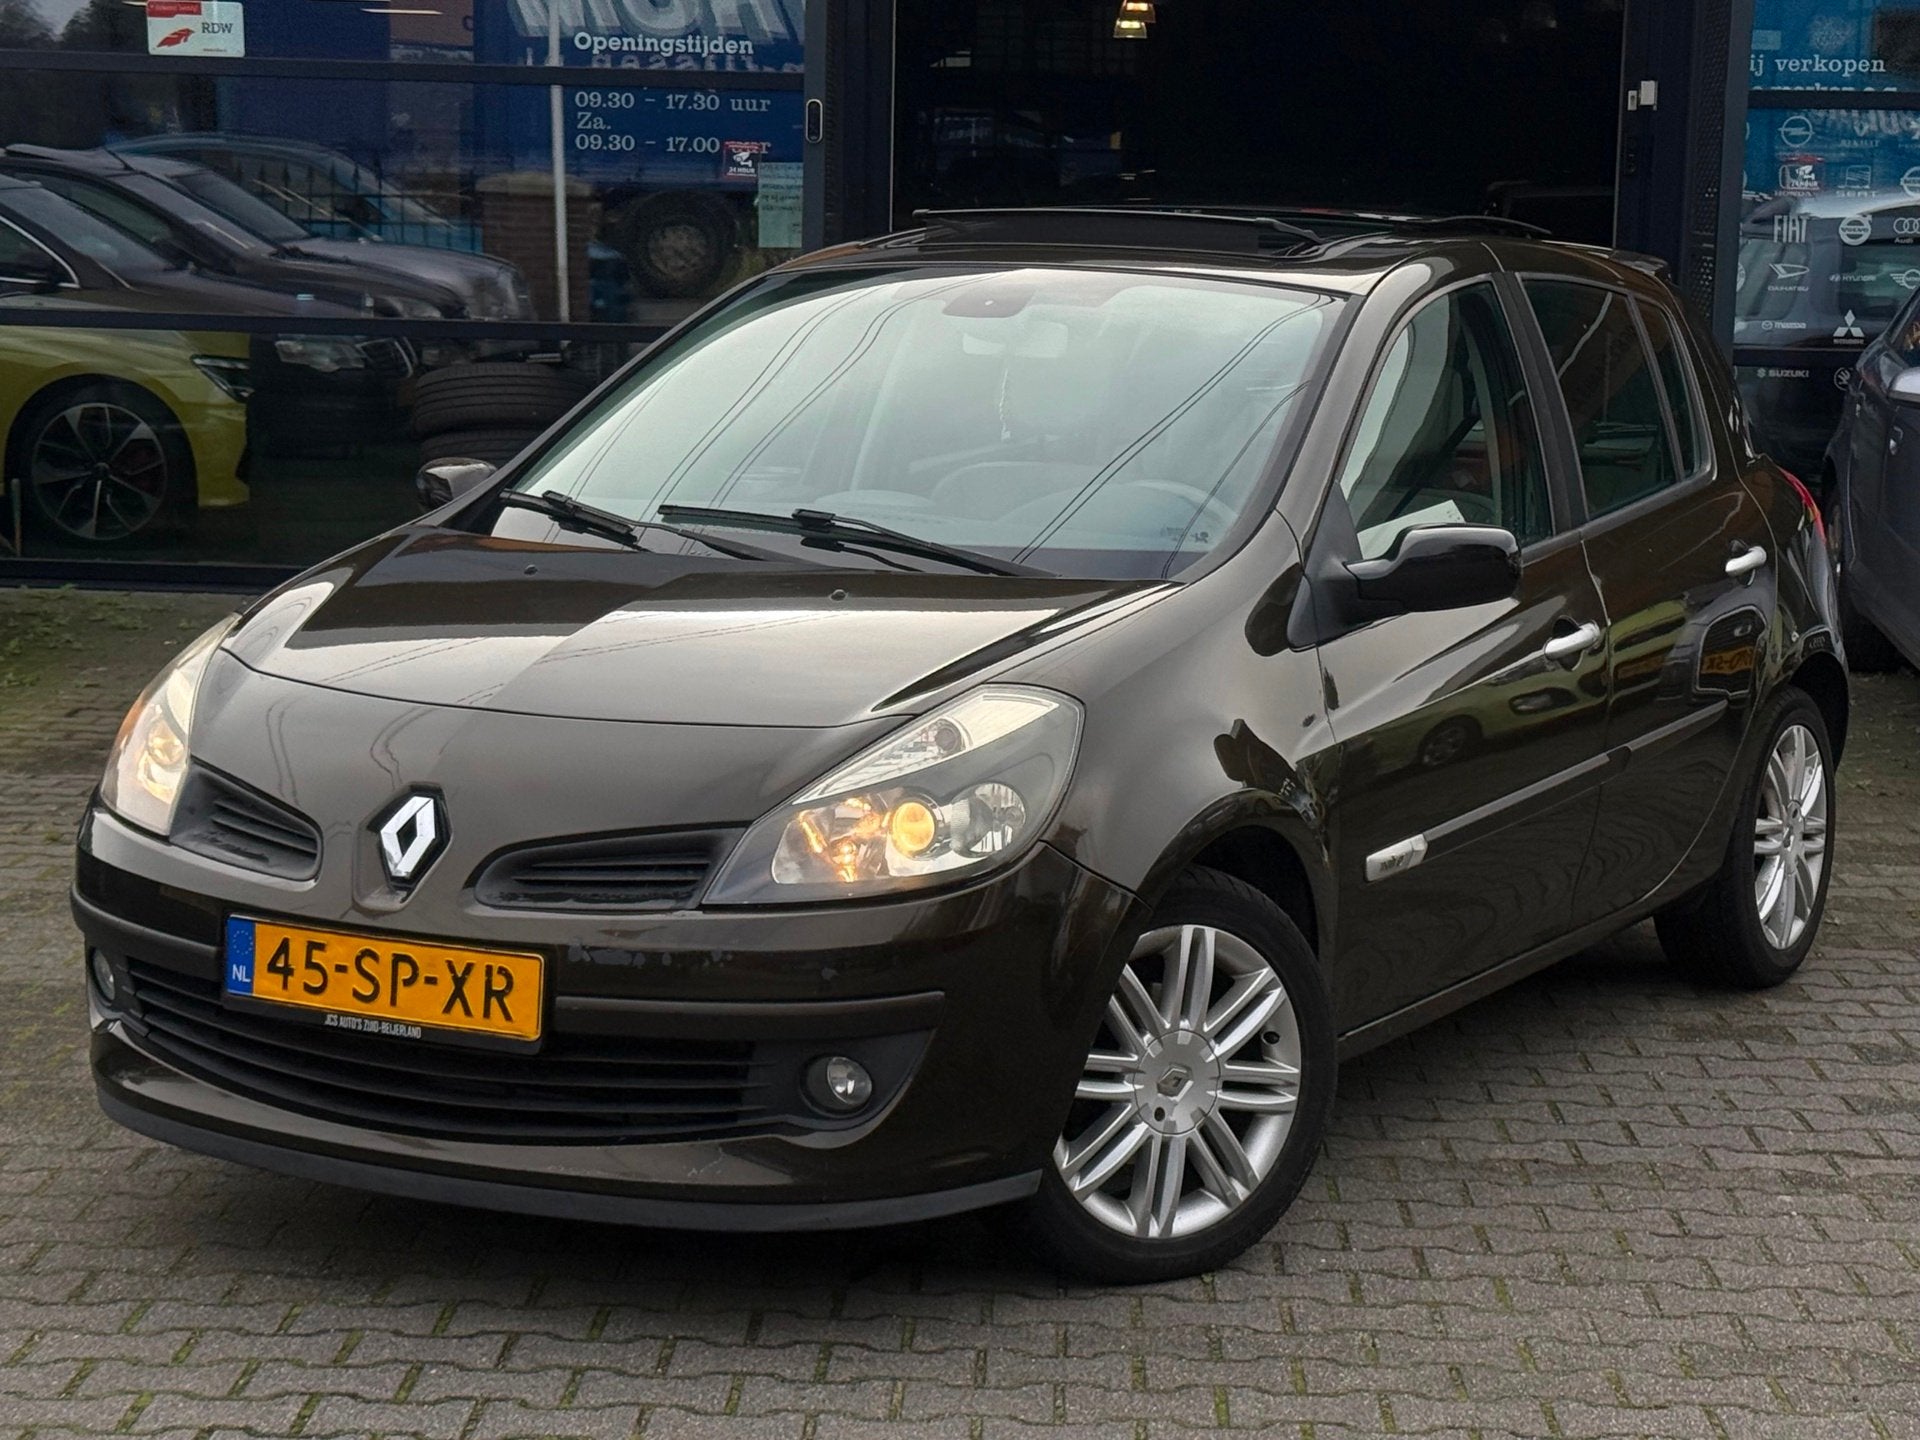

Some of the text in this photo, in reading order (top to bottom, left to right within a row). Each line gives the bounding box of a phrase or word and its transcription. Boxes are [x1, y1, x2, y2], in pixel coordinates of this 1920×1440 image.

[202, 22, 233, 34] RDW
[574, 31, 754, 57] Openingstijden
[1750, 54, 1886, 77] ij verkopen
[574, 91, 635, 108] 09.30
[666, 94, 720, 110] 17.30
[730, 98, 771, 112] uur
[577, 112, 611, 130] Za.
[575, 134, 635, 152] 09.30
[666, 136, 720, 153] 17.00
[1774, 215, 1810, 243] FIAT
[1768, 369, 1809, 378] SUZUKI
[232, 964, 252, 982] NL
[267, 937, 514, 1022] 45-SP-XR
